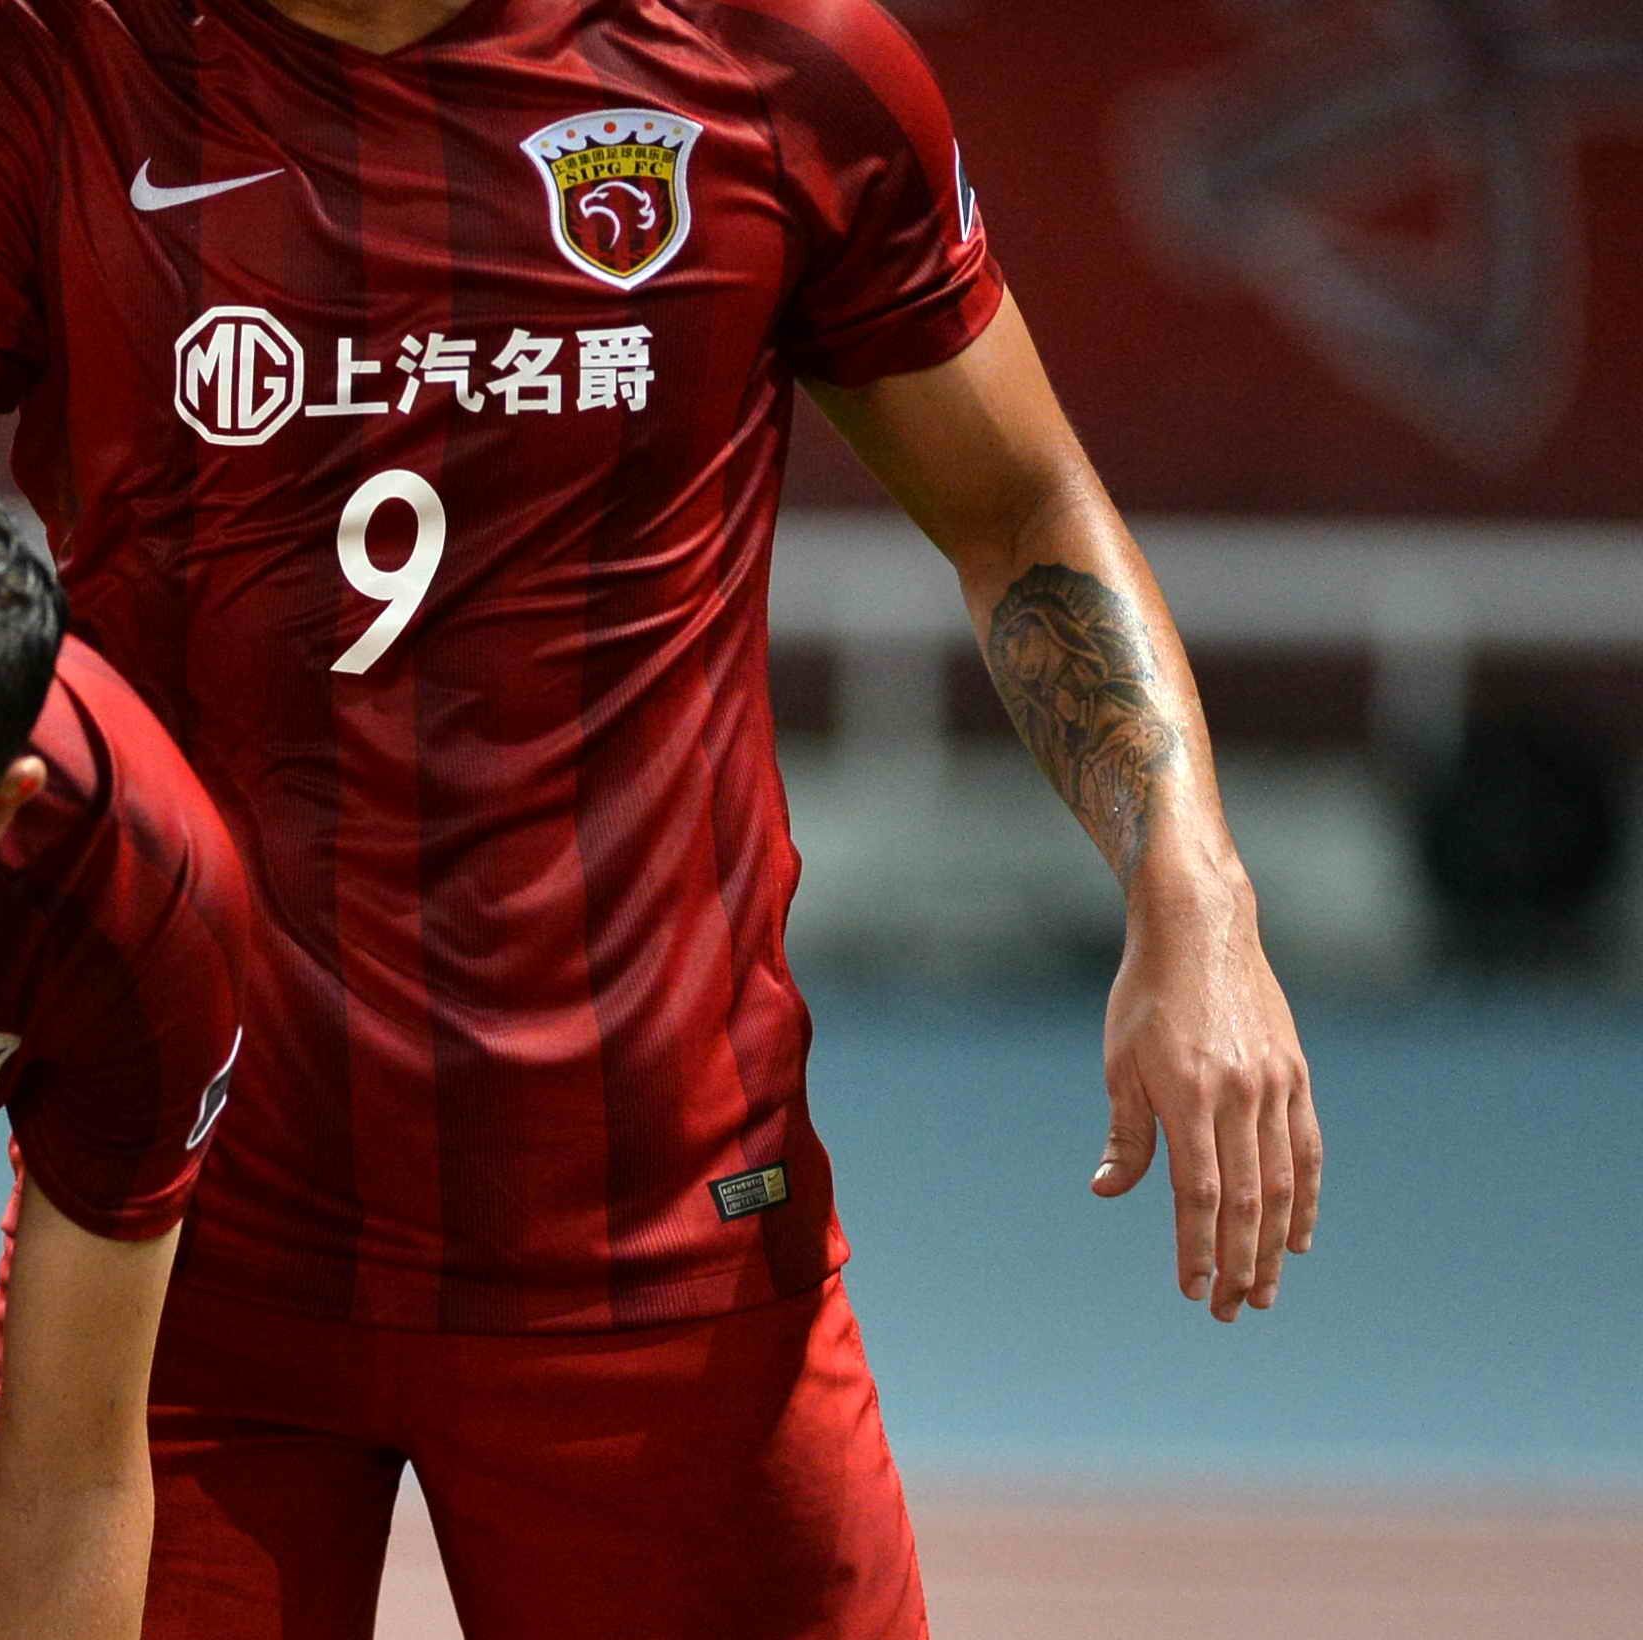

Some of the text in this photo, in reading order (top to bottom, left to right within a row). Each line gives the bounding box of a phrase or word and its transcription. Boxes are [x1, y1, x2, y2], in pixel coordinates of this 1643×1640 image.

[566, 160, 663, 184] SIPG FC
[182, 320, 656, 432] MG 上汽名爵
[331, 469, 447, 676] 9
